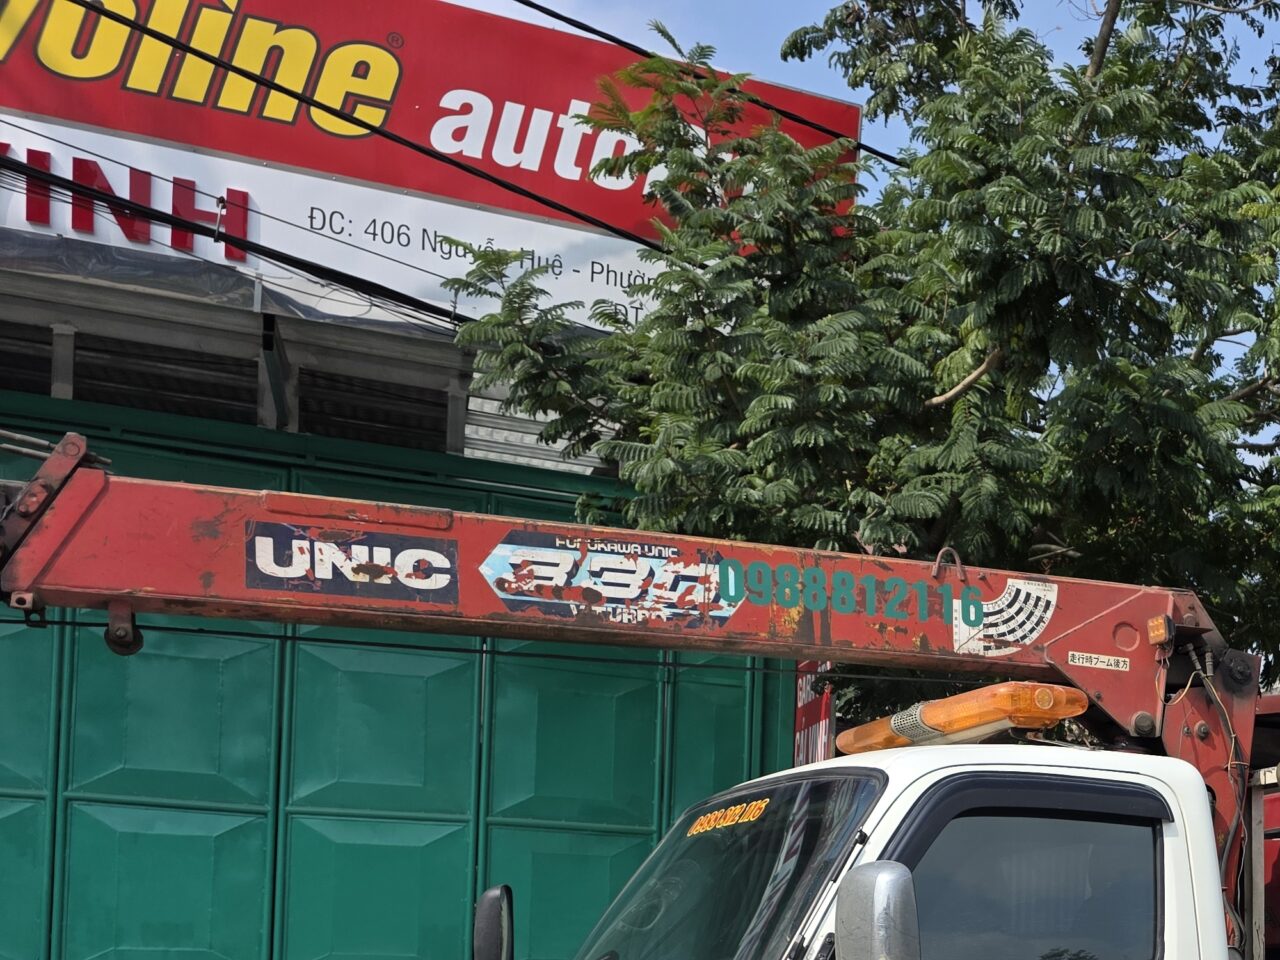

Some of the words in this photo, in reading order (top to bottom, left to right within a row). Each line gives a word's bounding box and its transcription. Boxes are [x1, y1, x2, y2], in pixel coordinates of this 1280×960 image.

[308, 206, 353, 237] ĐC:
[363, 218, 411, 247] 406
[519, 246, 564, 280] Huệ
[255, 535, 451, 590] UNIC
[718, 558, 985, 628] 0988812116
